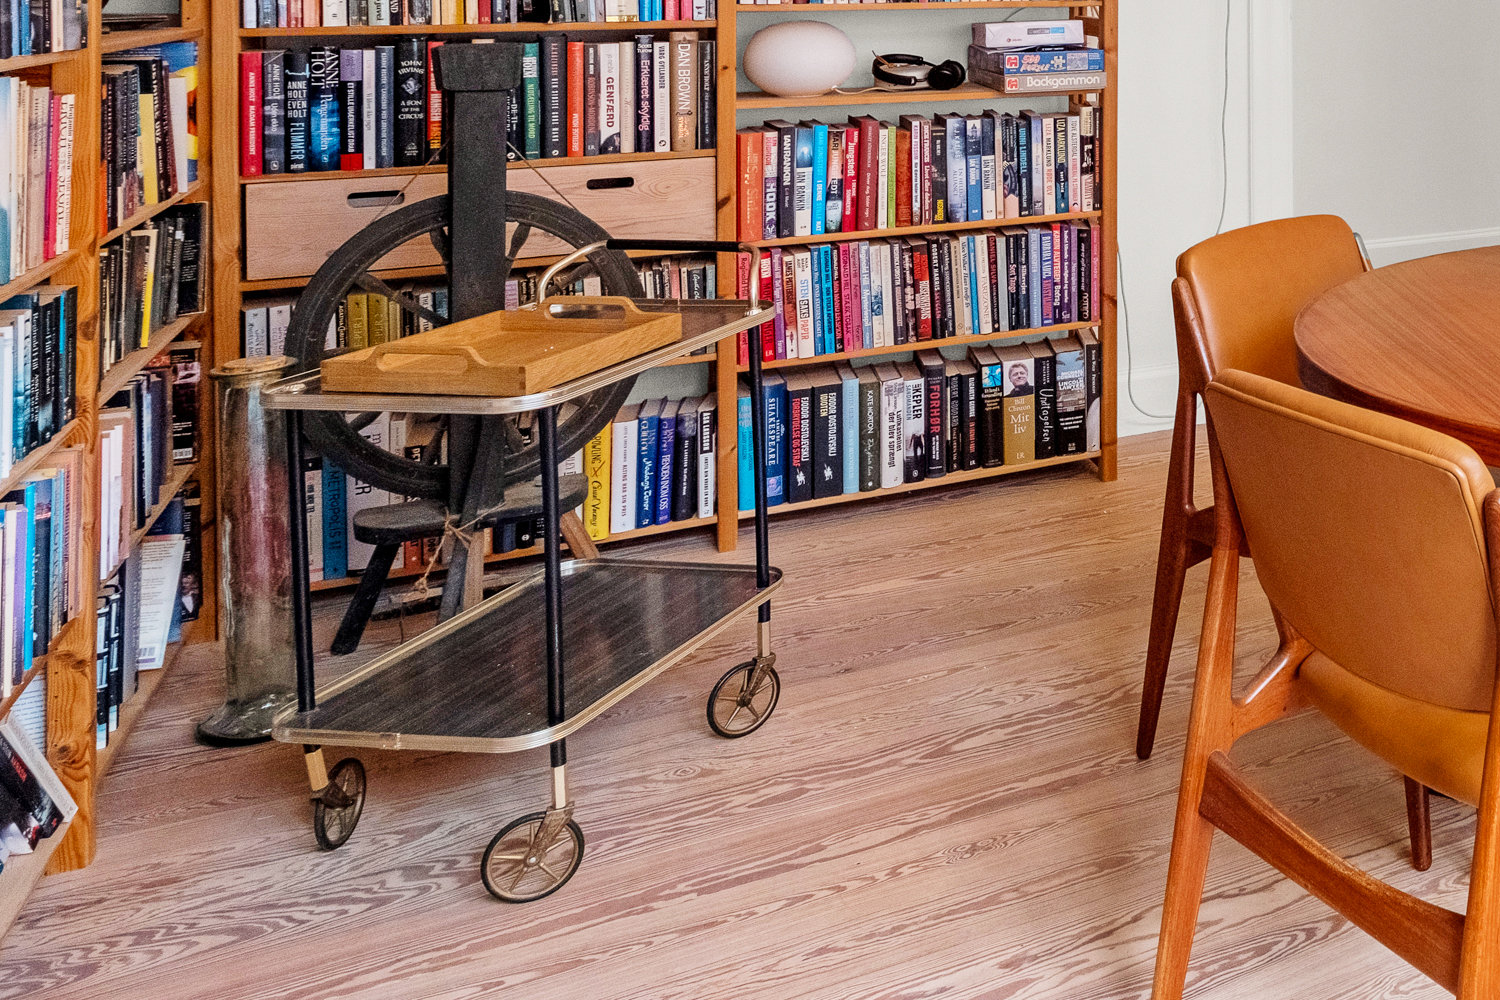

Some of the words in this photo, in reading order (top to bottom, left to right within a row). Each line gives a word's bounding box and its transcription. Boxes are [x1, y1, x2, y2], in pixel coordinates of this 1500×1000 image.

[375, 2, 383, 21] juvel
[678, 44, 690, 68] DAN
[1020, 54, 1041, 64] 500
[311, 51, 325, 87] HOLT
[325, 50, 339, 87] ANNE
[641, 60, 650, 98] Erklæret
[287, 80, 307, 90] ANNE
[678, 70, 690, 110] BROWN
[1026, 75, 1101, 89] Backgammon
[287, 90, 307, 99] HOLT
[287, 100, 307, 109] EVEN
[605, 77, 615, 128] GENFÆRD
[287, 109, 307, 118] HOLT
[320, 94, 333, 150] Pengemanden
[639, 100, 650, 131] skyldig
[1019, 128, 1027, 144] UNNI
[1056, 120, 1065, 133] LIZA
[289, 122, 305, 160] FLIMMER
[347, 139, 355, 153] DRAB
[1057, 133, 1066, 163] MARKLUND
[846, 142, 857, 176] Jungstedt
[1019, 146, 1027, 174] LINDELL
[796, 171, 807, 183] IAN
[796, 184, 806, 211] RANKIN
[1053, 230, 1061, 250] KARIN
[740, 257, 748, 285] Reginald
[1053, 250, 1061, 282] ALVTEGEN
[741, 286, 749, 297] Hill
[800, 280, 809, 298] STEN
[1008, 277, 1016, 293] Tango
[1053, 285, 1061, 306] Bedrag
[800, 300, 809, 318] SAKS
[801, 319, 809, 340] PAPIR
[801, 397, 810, 418] FJODOR
[820, 393, 828, 417] IDIOTEN
[828, 392, 837, 414] FJODOR
[912, 388, 923, 420] KEPLER
[930, 385, 944, 433] FORHØR
[1010, 413, 1030, 424] Mit
[1038, 388, 1054, 442] Undtagelsen
[767, 398, 775, 466] SHAKESPEARE
[801, 419, 810, 461] DOSTOJEVSKIJ
[828, 415, 837, 456] DOSTOJEVSKIJ
[1014, 423, 1027, 435] liv
[659, 454, 670, 480] FIENDEN
[660, 481, 669, 496] INOM
[660, 497, 669, 510] OSS
